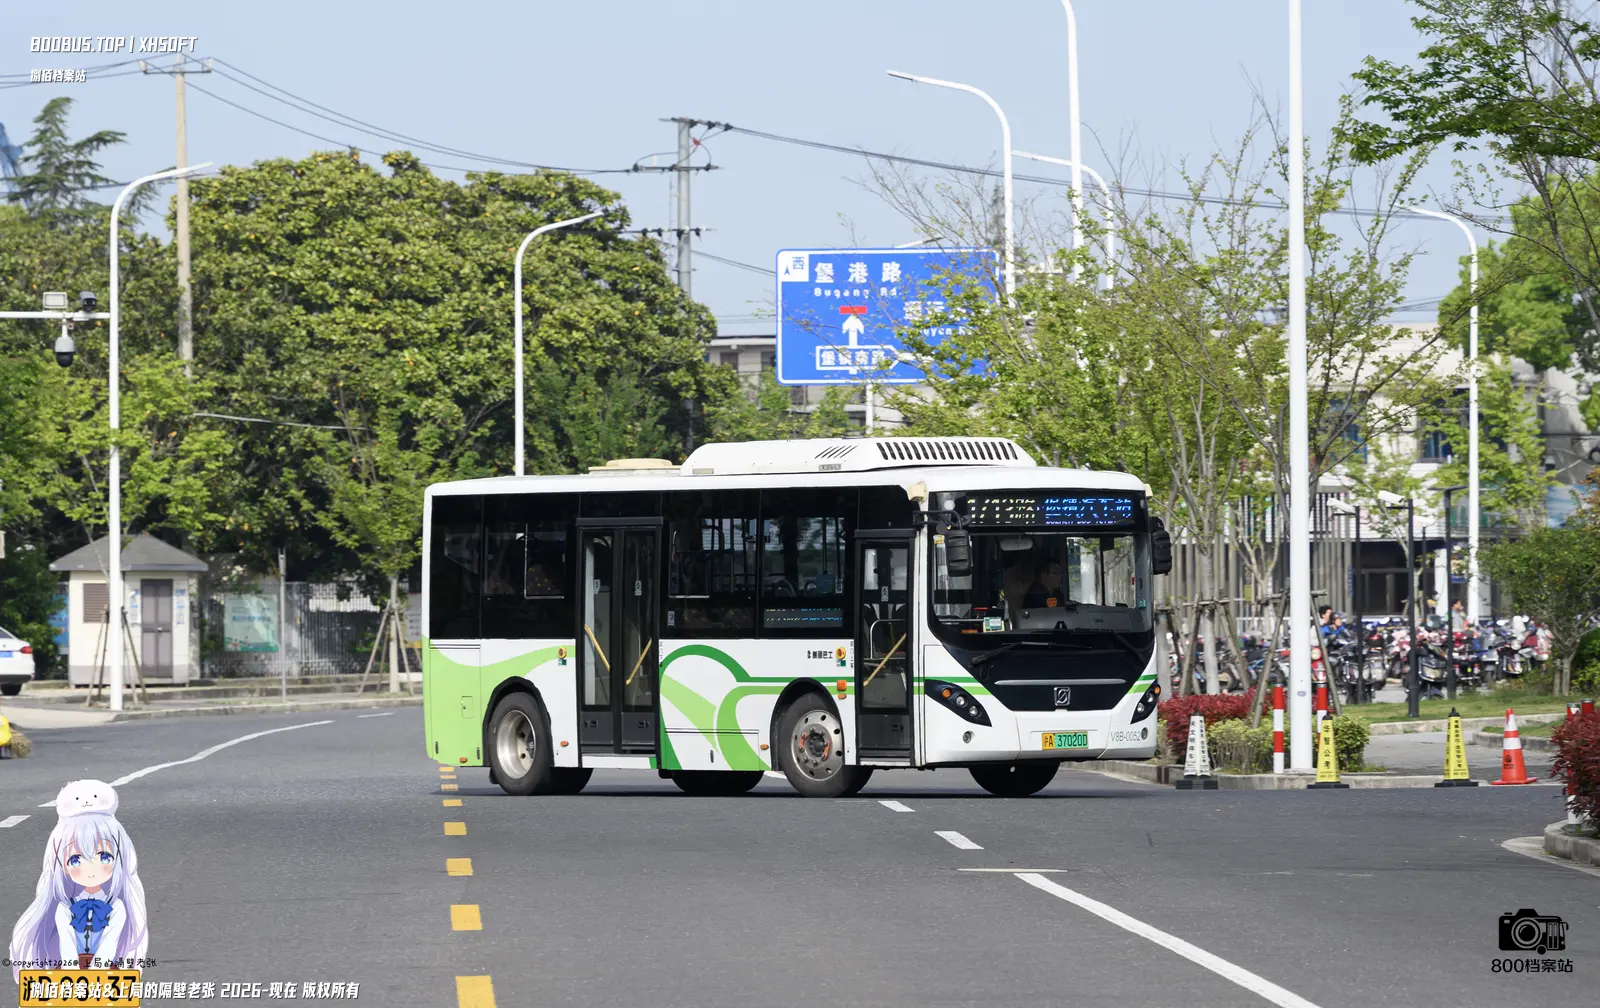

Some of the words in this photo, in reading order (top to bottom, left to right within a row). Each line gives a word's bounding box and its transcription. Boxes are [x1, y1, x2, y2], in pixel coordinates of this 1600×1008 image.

[792, 256, 805, 270] 西
[815, 261, 902, 283] 堡港路
